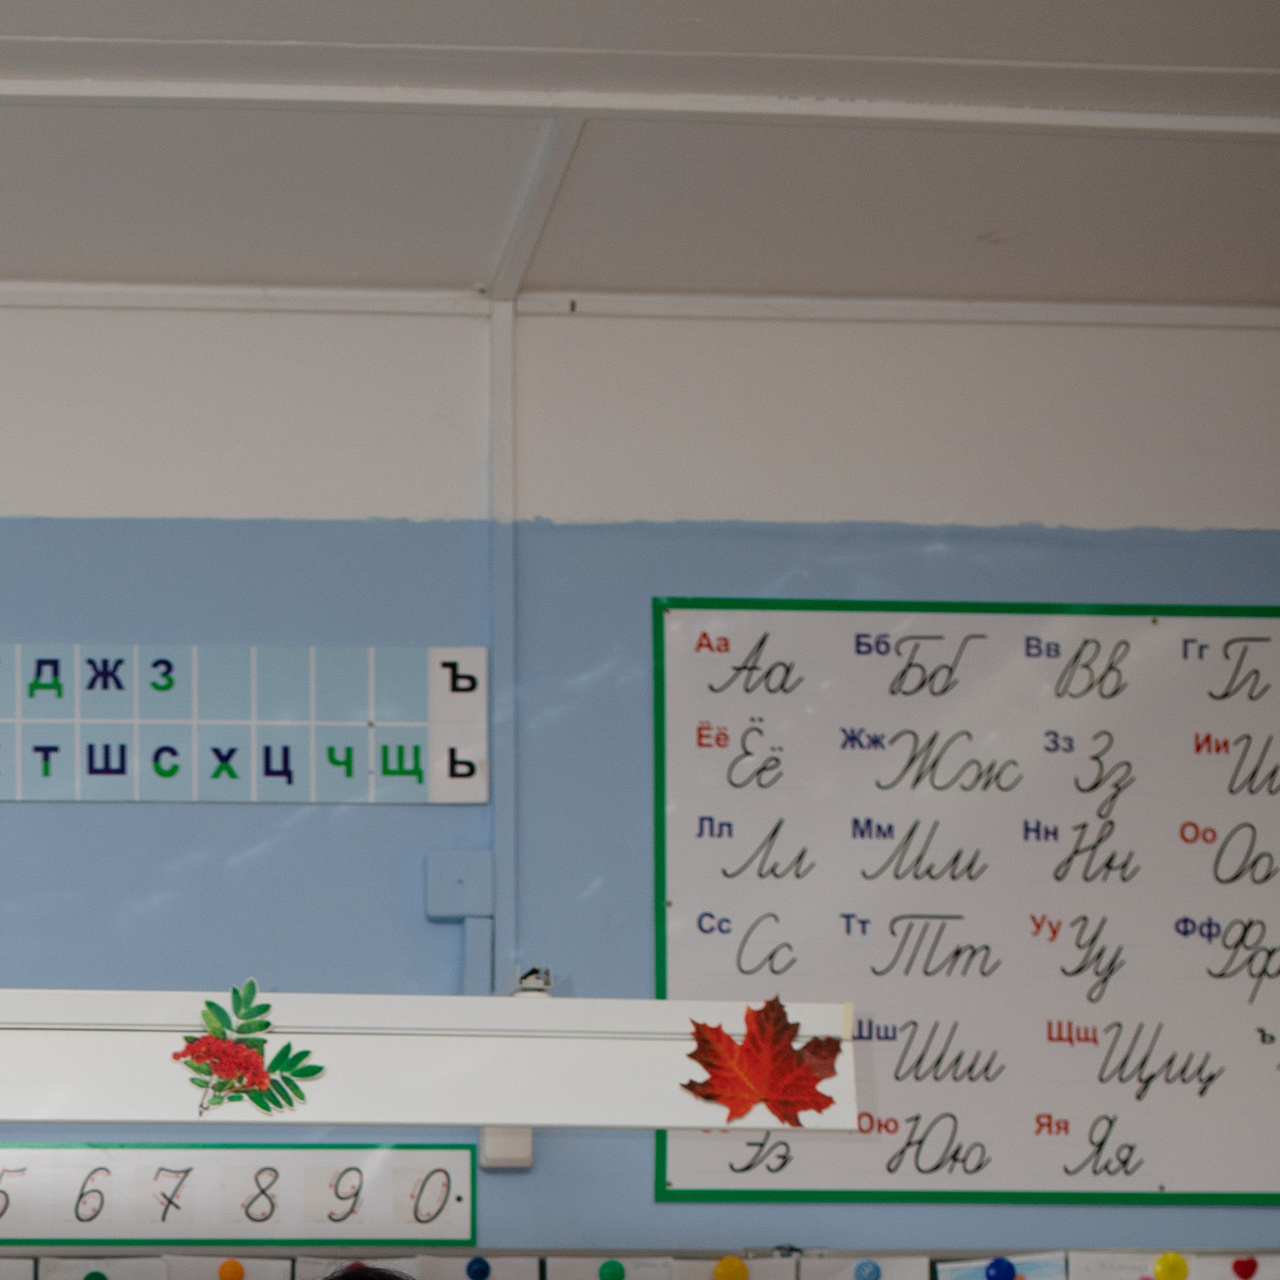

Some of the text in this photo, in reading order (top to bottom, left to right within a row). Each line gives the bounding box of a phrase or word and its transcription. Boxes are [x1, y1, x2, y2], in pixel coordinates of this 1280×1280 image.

[29, 659, 62, 698] д
[87, 659, 123, 689] ж
[151, 659, 174, 691] з
[442, 662, 476, 692] ъ
[695, 632, 1272, 701] Аа Аа Бб Бб Вв Вв Гг Гг
[34, 746, 58, 776] т
[88, 744, 126, 774] ш
[154, 746, 179, 777] с
[211, 748, 237, 778] х
[264, 746, 293, 784] ц
[328, 746, 353, 777] ч
[382, 745, 423, 784] щ
[450, 748, 475, 777] ь
[696, 717, 1230, 819] Ёё Ёё Жж Жж Зз Зз Ии
[696, 816, 733, 839] Лл
[722, 818, 816, 880] Лл
[851, 818, 894, 841] Мм
[861, 818, 989, 881] Мм
[1023, 820, 1058, 843] Нн
[1053, 820, 1140, 884] Нн
[1180, 821, 1217, 844] Оо
[697, 911, 1222, 1003] Сс Сс Тт Тт Уу Уу Фф
[894, 1019, 1005, 1083] Шш
[1046, 1019, 1099, 1046] Щщ
[1098, 1021, 1225, 1101] Щщ
[887, 1112, 1144, 1178] Юю Яя Яя
[73, 1167, 112, 1223] 6
[154, 1167, 193, 1223] 7
[243, 1167, 279, 1223] 8
[326, 1167, 364, 1223] 9
[412, 1167, 453, 1223] 0
